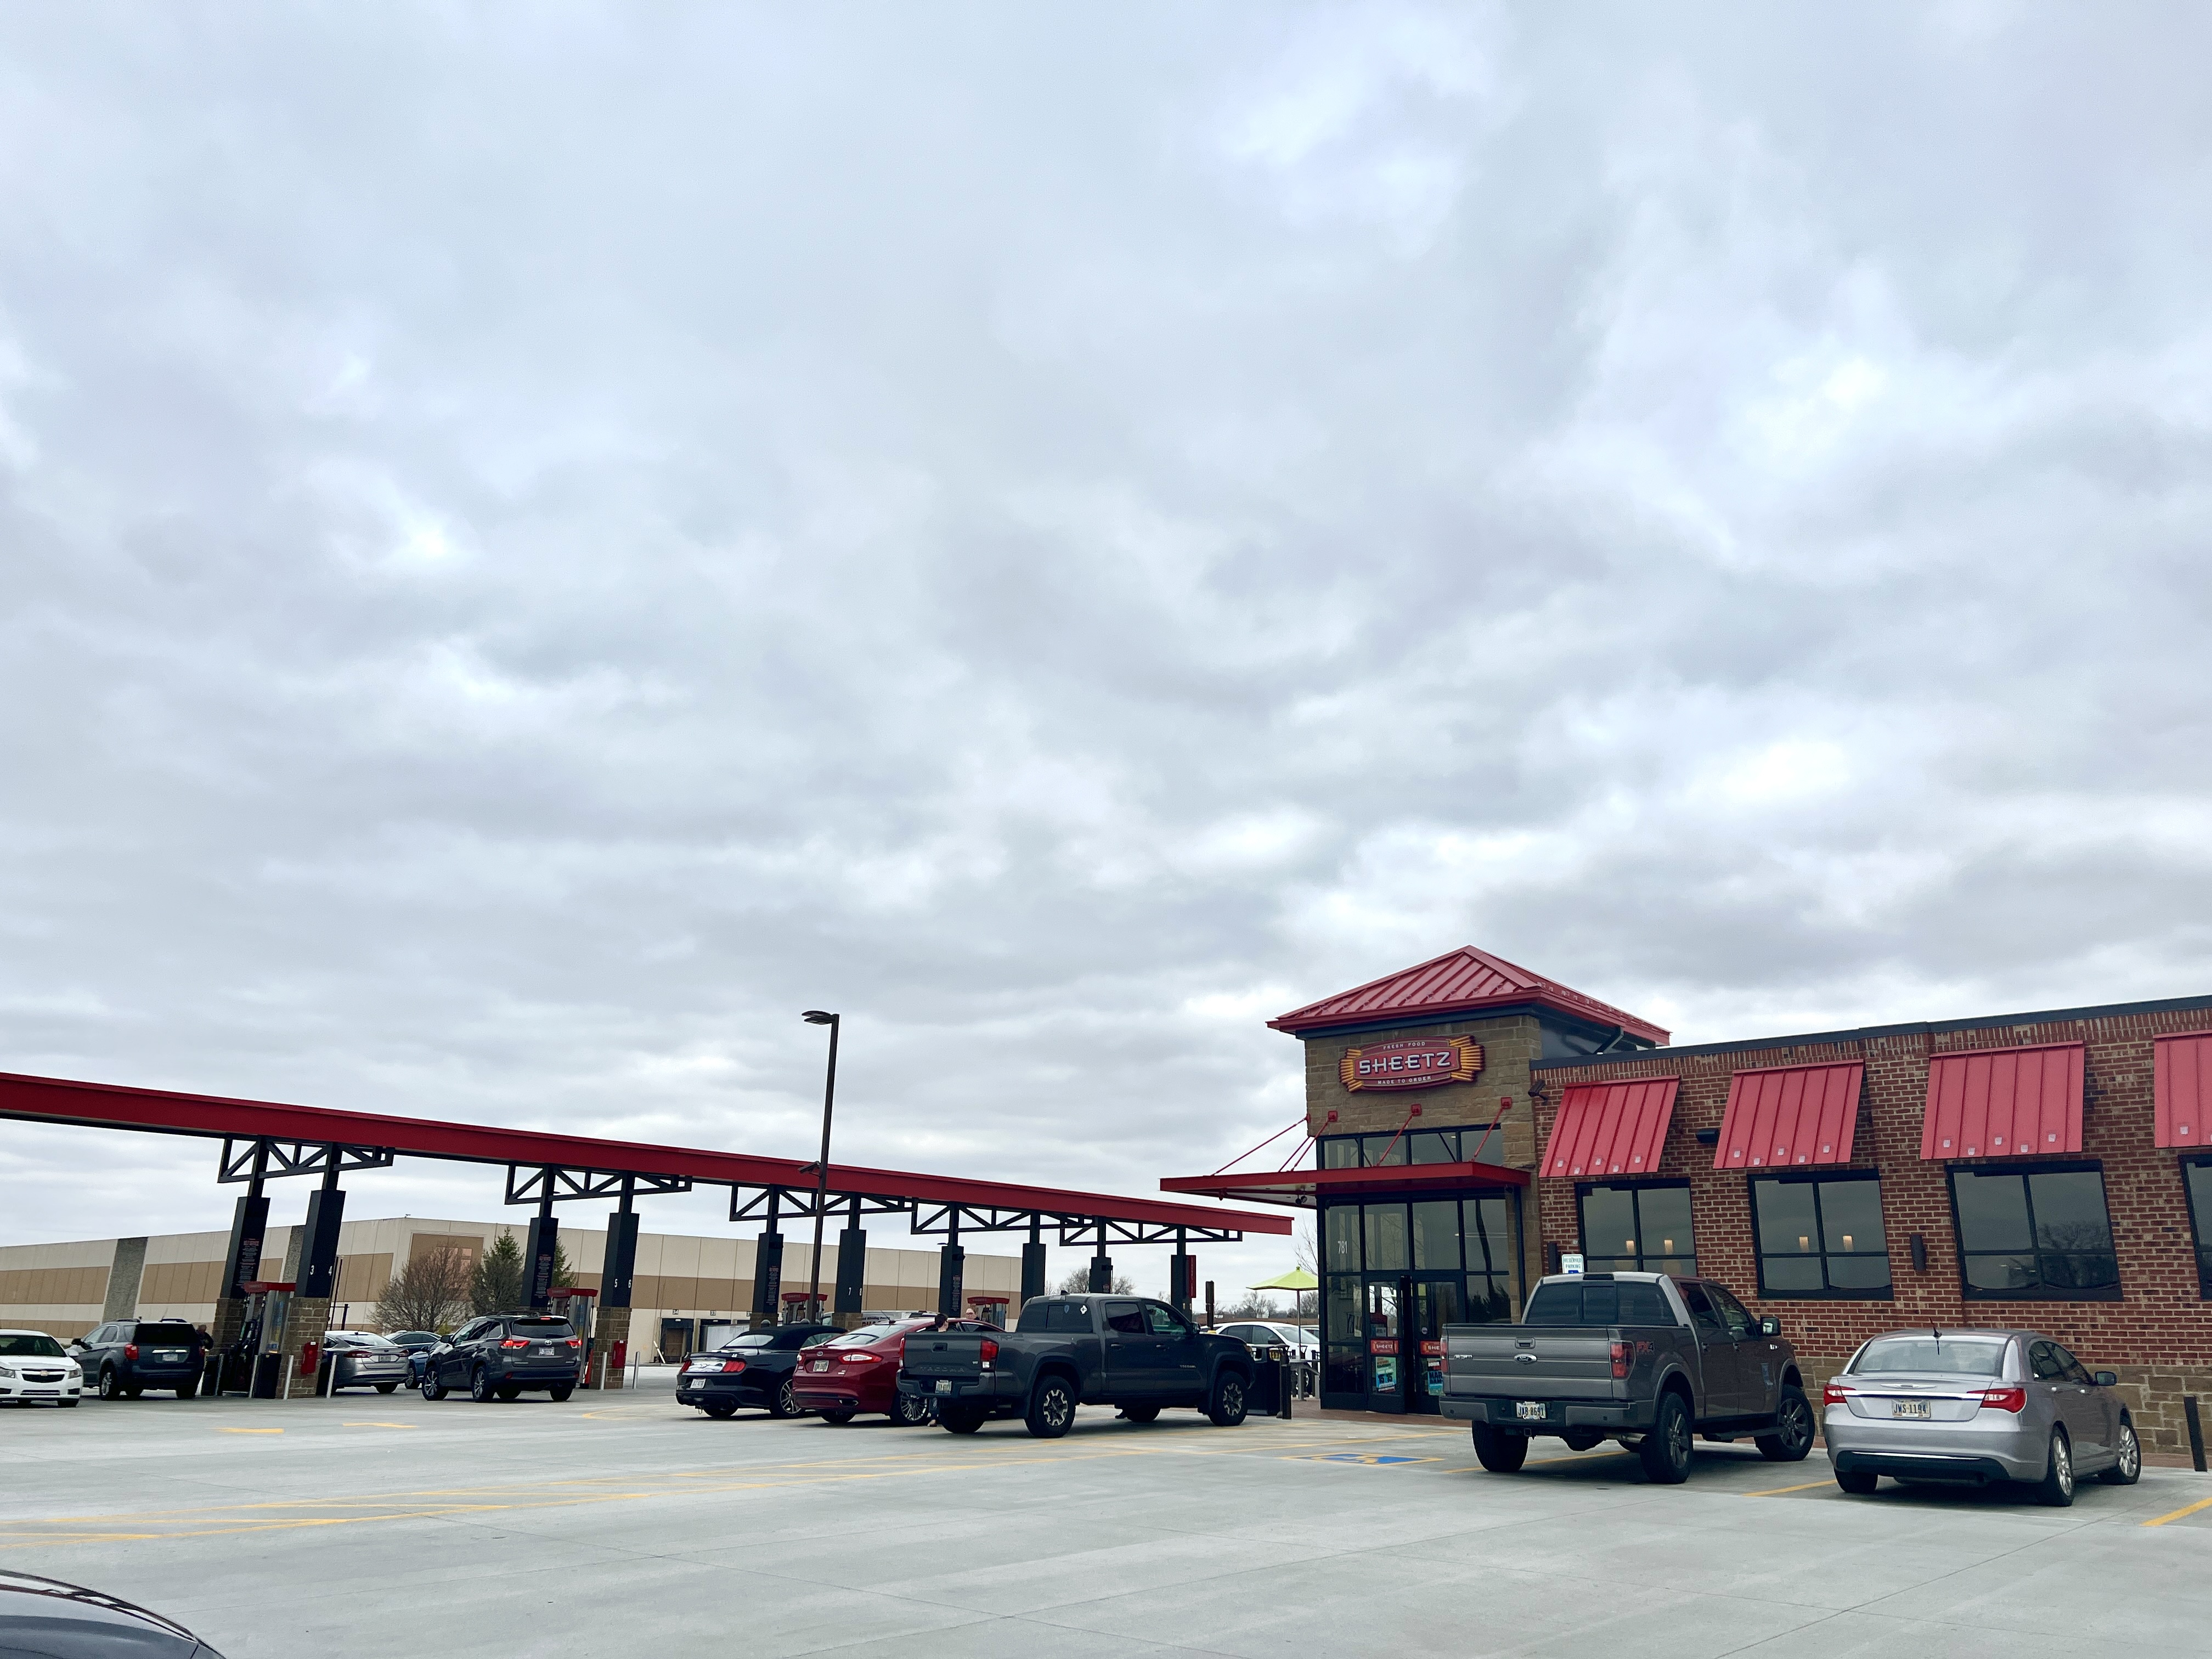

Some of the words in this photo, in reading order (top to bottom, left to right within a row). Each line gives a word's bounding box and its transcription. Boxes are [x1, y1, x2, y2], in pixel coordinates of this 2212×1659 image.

[1359, 1051, 1451, 1075] SHEETZ
[1338, 1240, 1347, 1254] 781
[310, 1265, 314, 1275] 3
[329, 1266, 332, 1276] 4
[614, 1279, 618, 1288] 5
[628, 1279, 631, 1288] 6
[848, 1287, 851, 1296] 7
[1636, 1341, 1655, 1352] FX4
[1530, 1407, 1544, 1416] 8691
[1909, 1404, 1926, 1414] 1194
